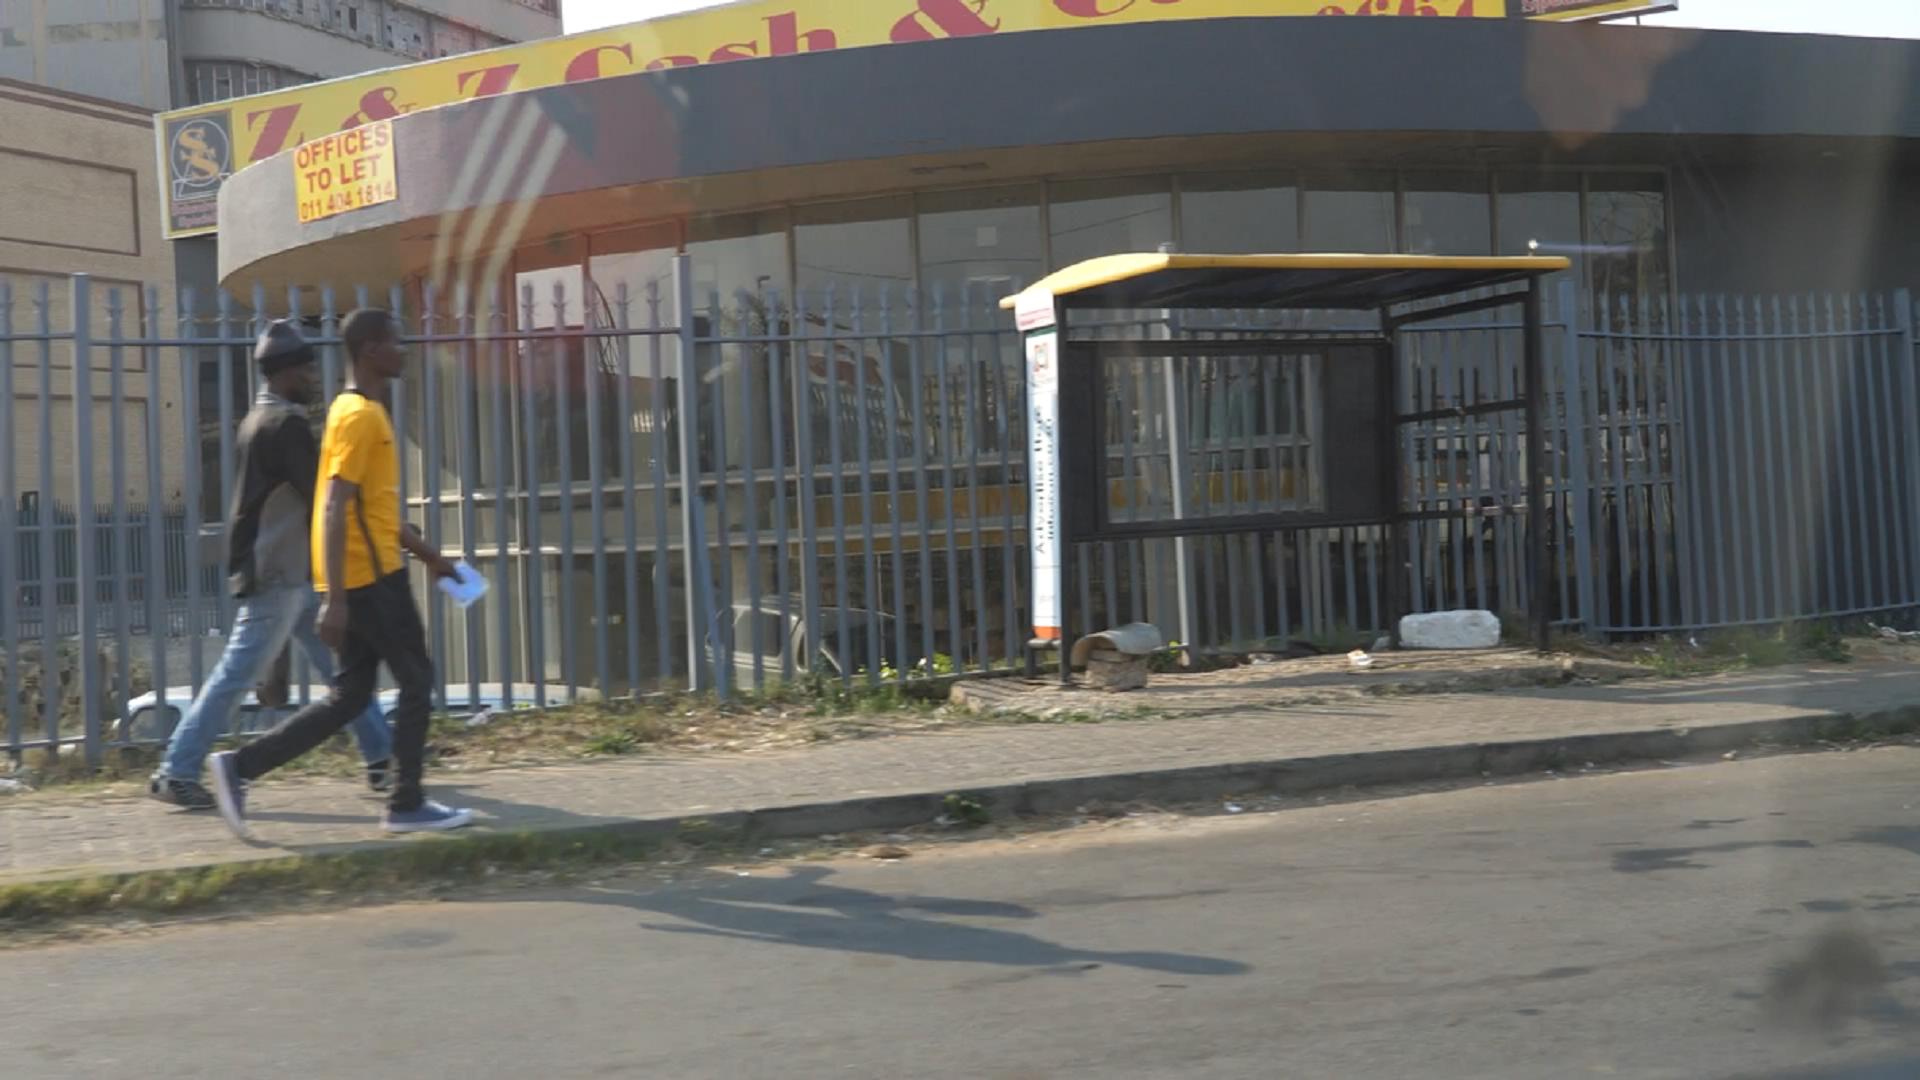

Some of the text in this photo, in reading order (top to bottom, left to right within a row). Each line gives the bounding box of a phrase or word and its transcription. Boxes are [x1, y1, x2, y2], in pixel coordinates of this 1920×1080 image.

[247, 102, 304, 162] Z
[297, 124, 388, 169] OFFICES
[305, 154, 382, 193] TO LET
[301, 181, 393, 220] 011 404 1814
